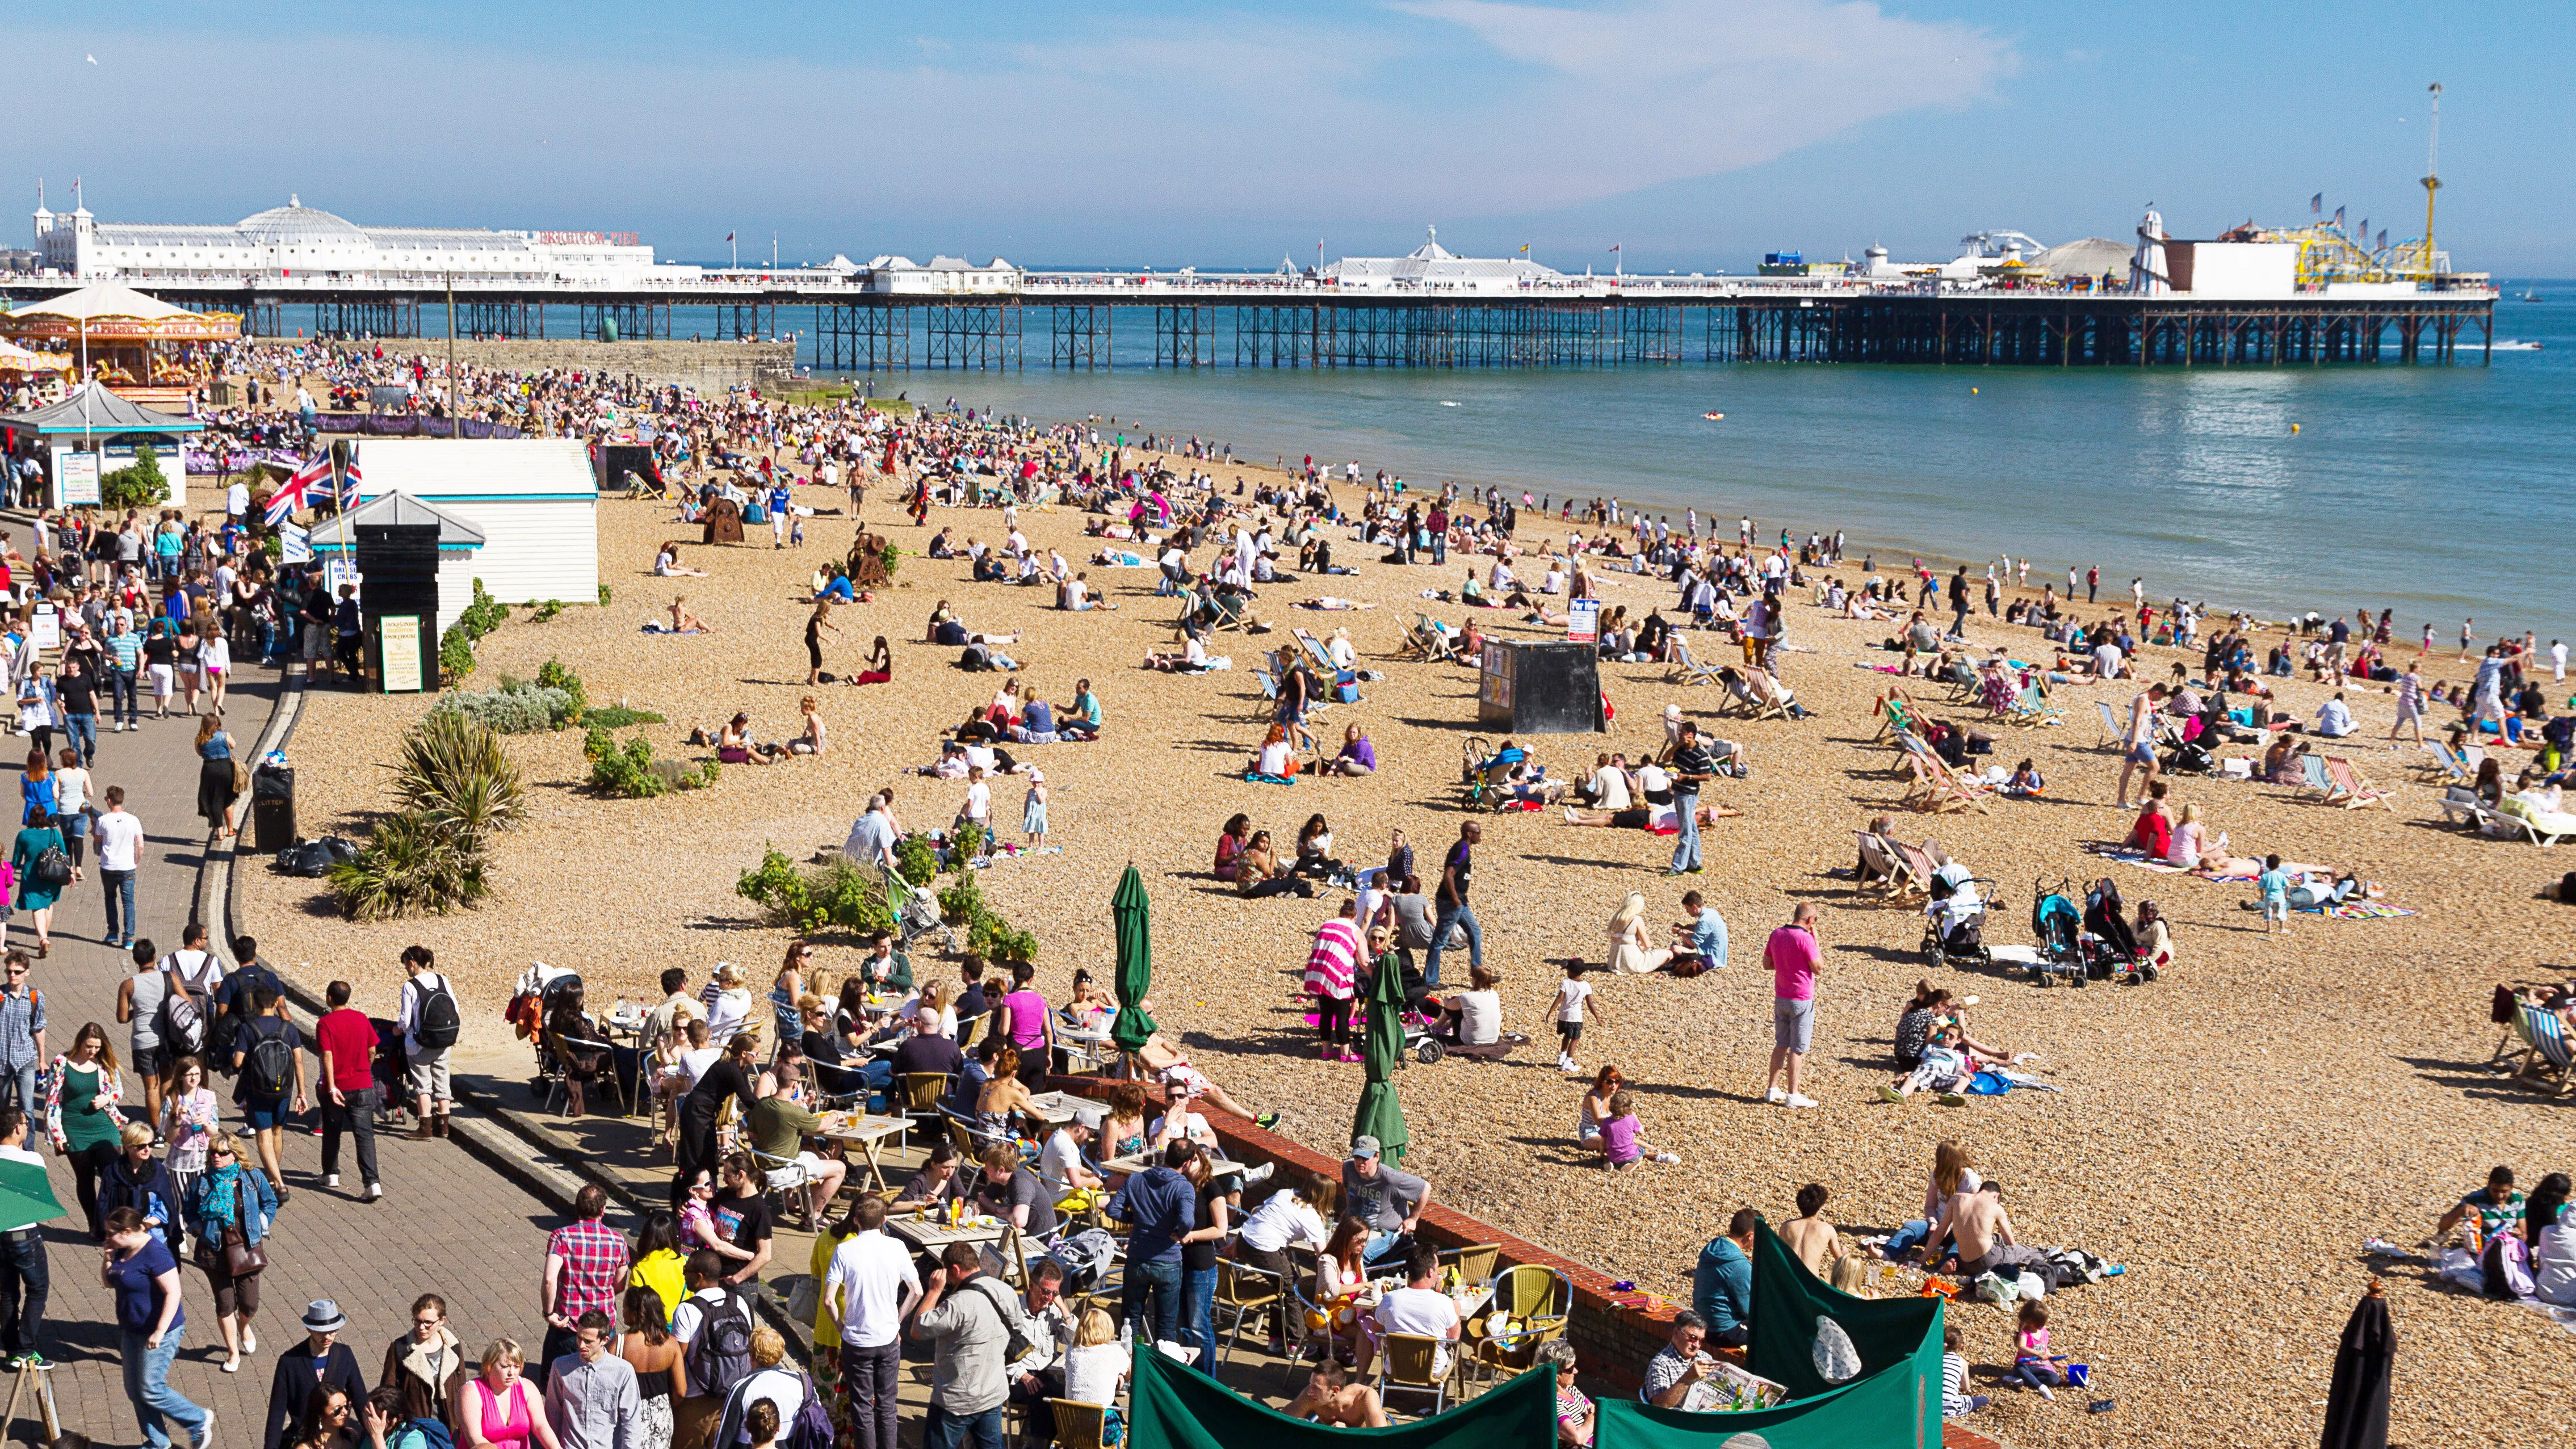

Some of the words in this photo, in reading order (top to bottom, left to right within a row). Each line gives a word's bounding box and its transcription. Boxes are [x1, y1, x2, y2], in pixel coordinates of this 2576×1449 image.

[539, 231, 605, 244] BRIGHTON
[610, 232, 640, 245] PIER
[286, 540, 306, 553] Jellied
[1572, 600, 1584, 611] For
[1584, 600, 1599, 611] Hire
[1357, 1185, 1381, 1200] 1958
